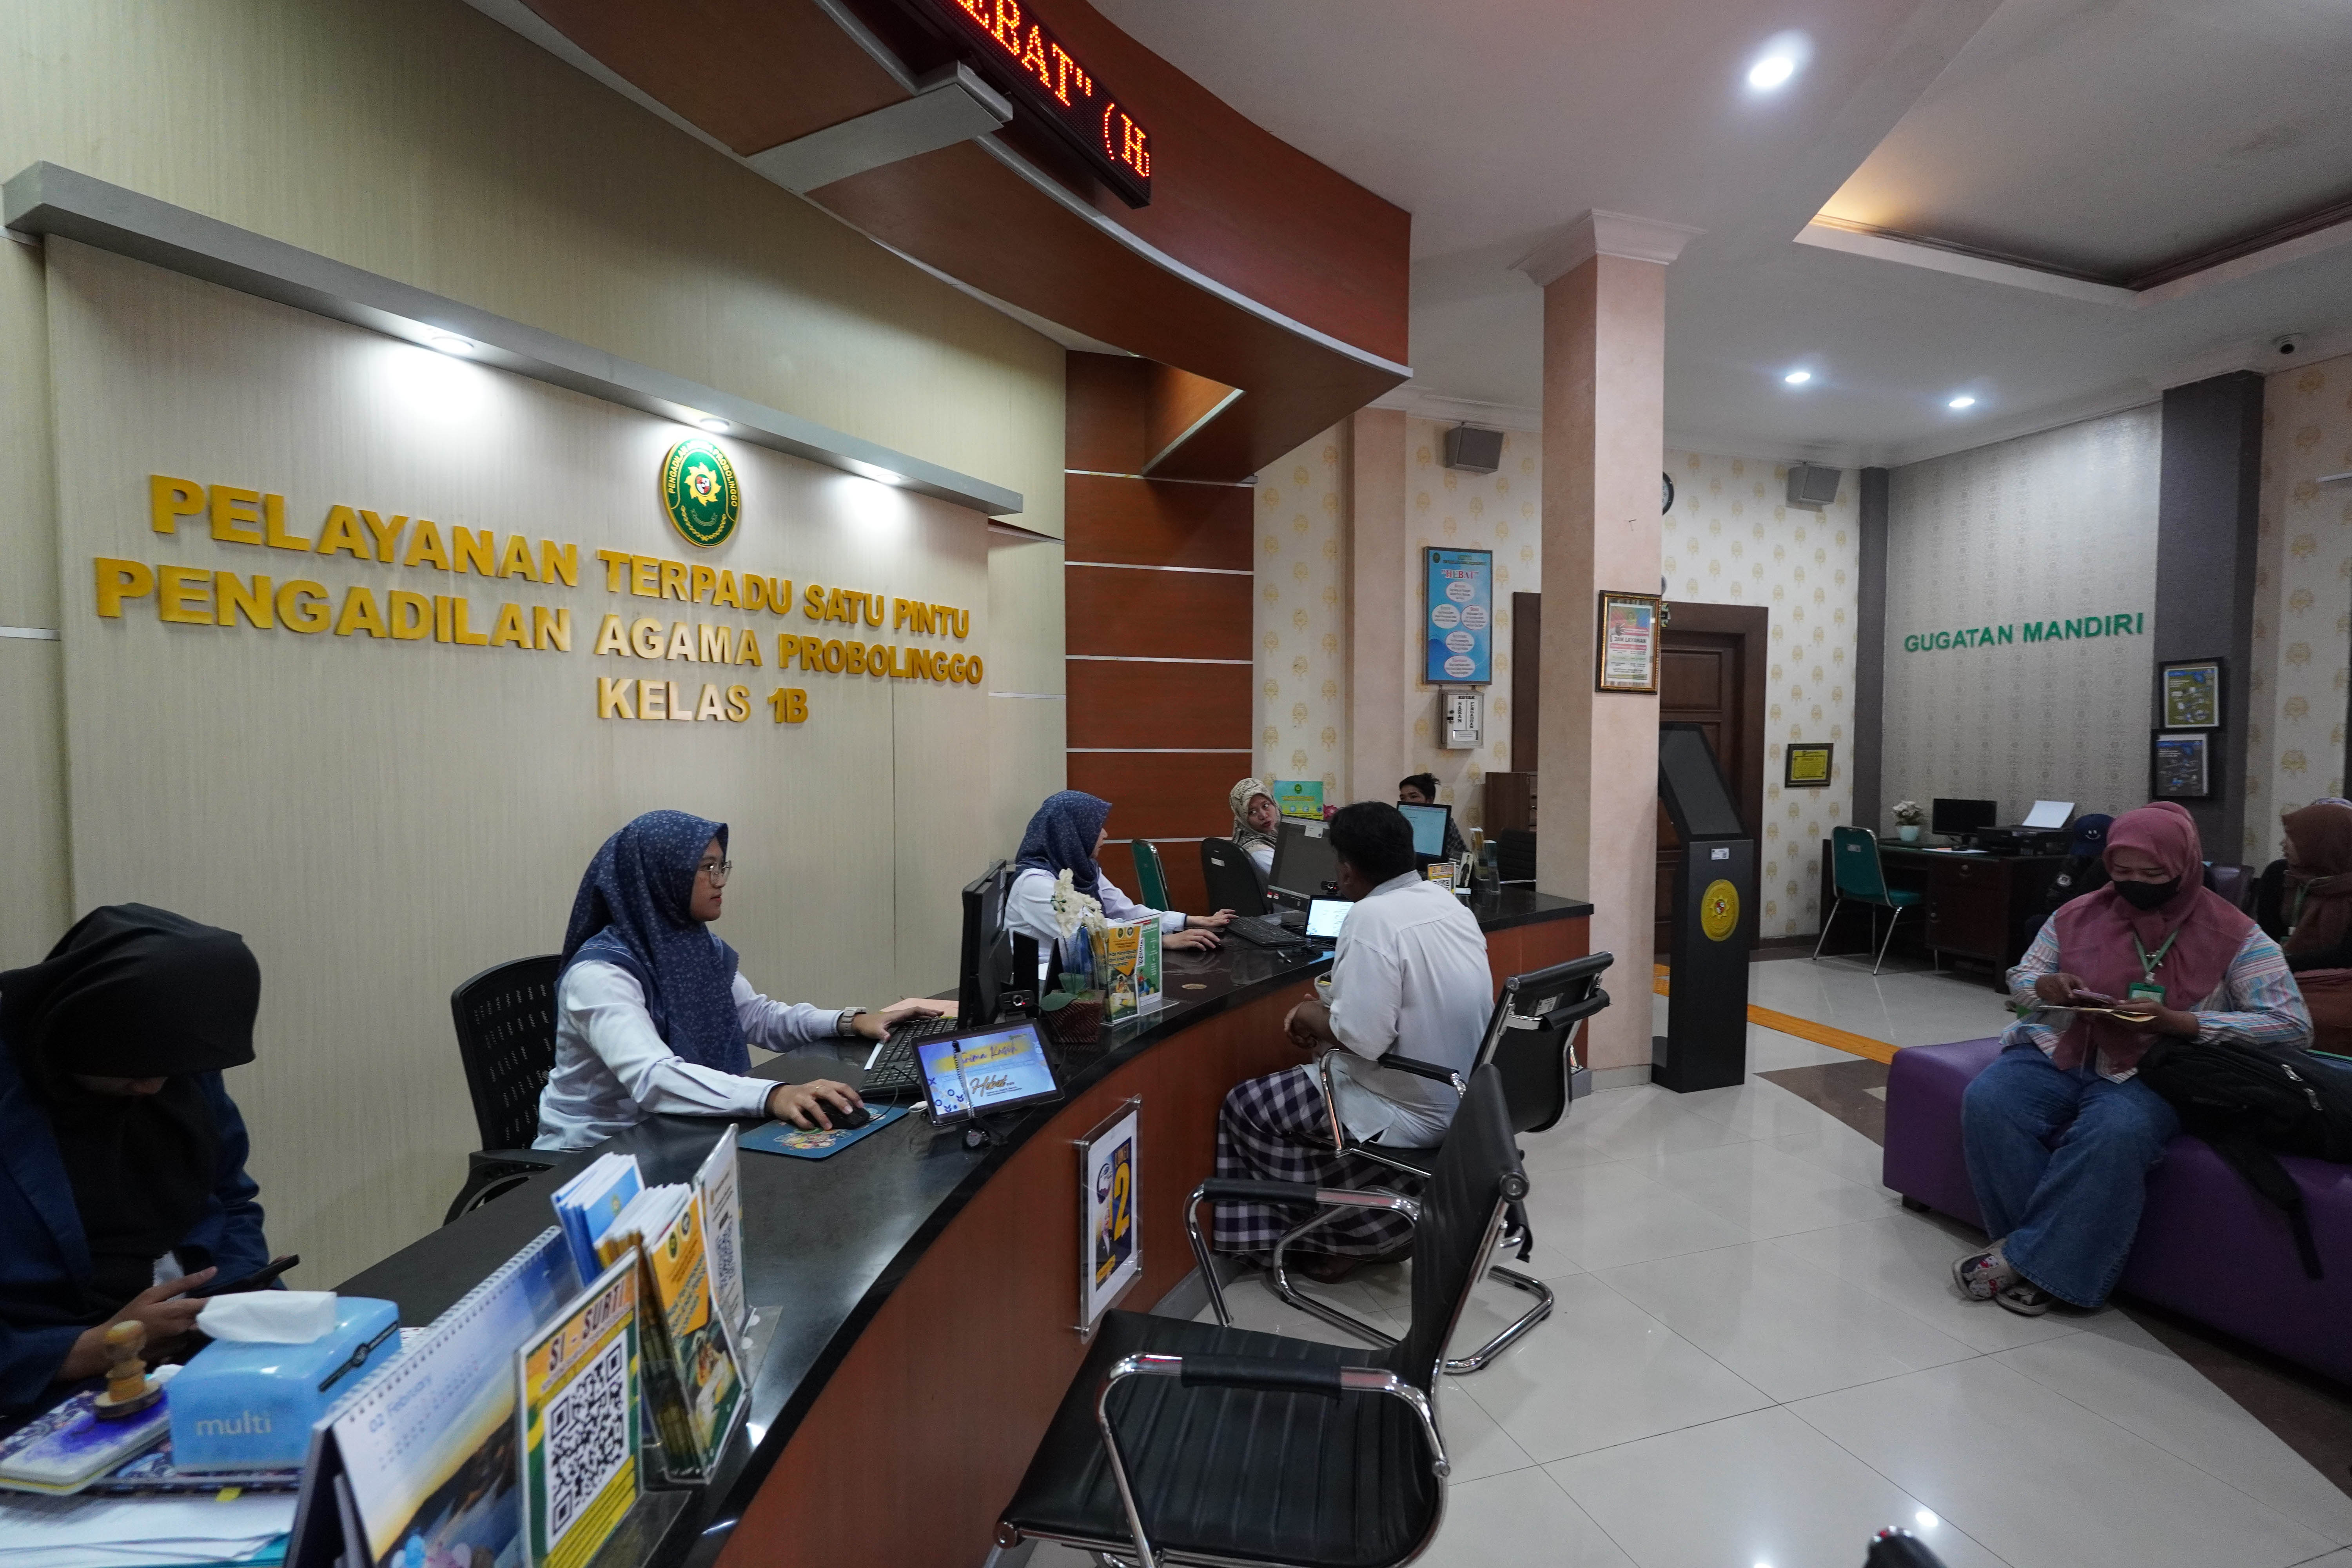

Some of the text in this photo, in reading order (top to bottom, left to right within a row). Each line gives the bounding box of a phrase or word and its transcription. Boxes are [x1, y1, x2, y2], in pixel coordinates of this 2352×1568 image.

[150, 475, 969, 638] PELAYANAN TERPADU SATU PINTU
[1441, 570, 1479, 579] "HEBAT"
[94, 557, 983, 684] PENGADILAN AGAMA PROBOLINGGO
[1905, 612, 2144, 652] GUGATAN MANDIRI
[597, 677, 808, 723] KELAS 1B
[549, 1332, 566, 1371] SI
[582, 1278, 626, 1340] SURTI
[195, 1410, 272, 1436] multi
[369, 1413, 385, 1434] 02
